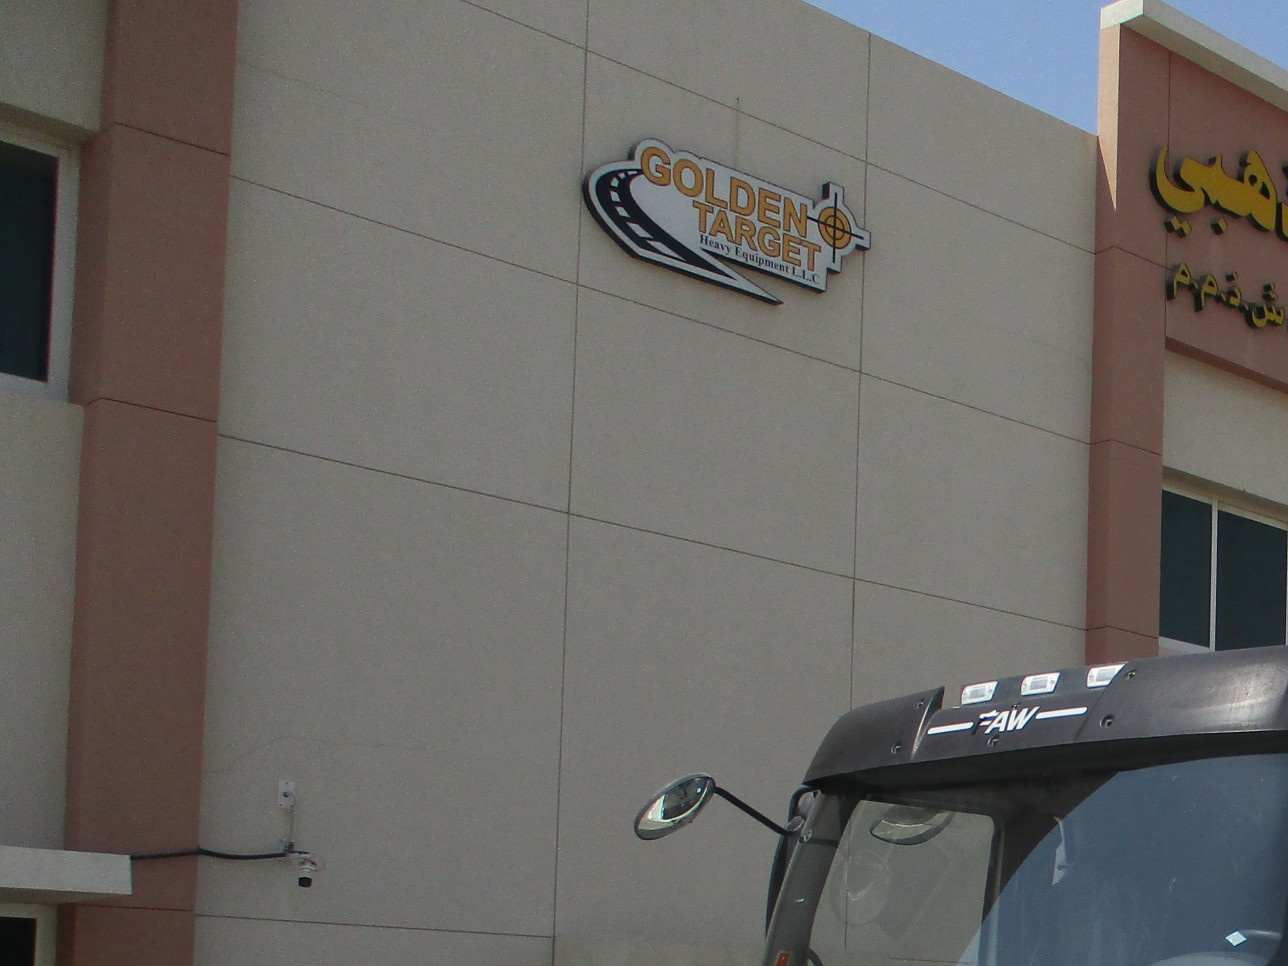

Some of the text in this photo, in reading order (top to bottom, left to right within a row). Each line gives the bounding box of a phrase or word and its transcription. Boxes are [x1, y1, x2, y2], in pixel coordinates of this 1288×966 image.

[640, 146, 807, 238] GOLDEN
[692, 200, 821, 272] TARGET
[699, 233, 821, 285] Heavy Equipment L.L.C
[977, 705, 1041, 735] FAW
